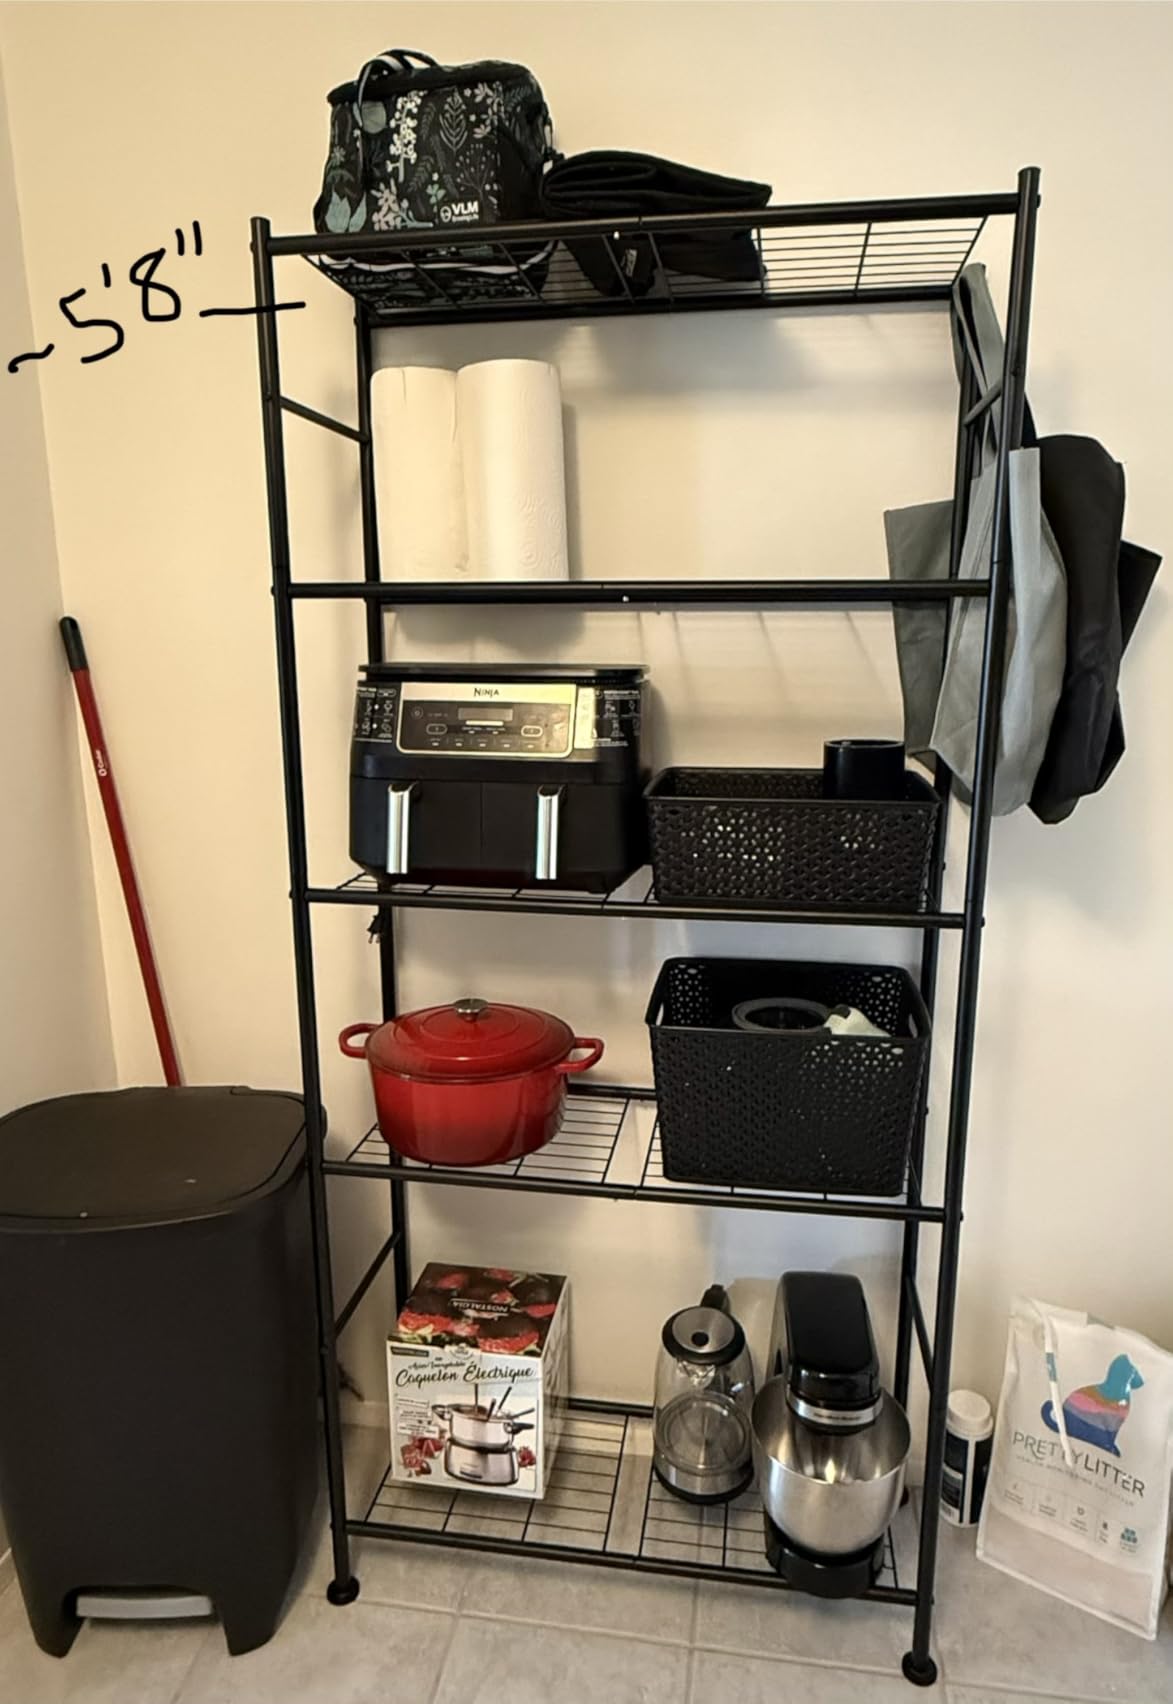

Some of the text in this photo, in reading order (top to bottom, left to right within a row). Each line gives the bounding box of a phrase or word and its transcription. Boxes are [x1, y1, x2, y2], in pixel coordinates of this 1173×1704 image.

[451, 201, 479, 215] VLM
[452, 1301, 508, 1312] NOSTALGIA
[395, 1369, 458, 1389] Caquelon
[463, 1361, 534, 1384] Électrique
